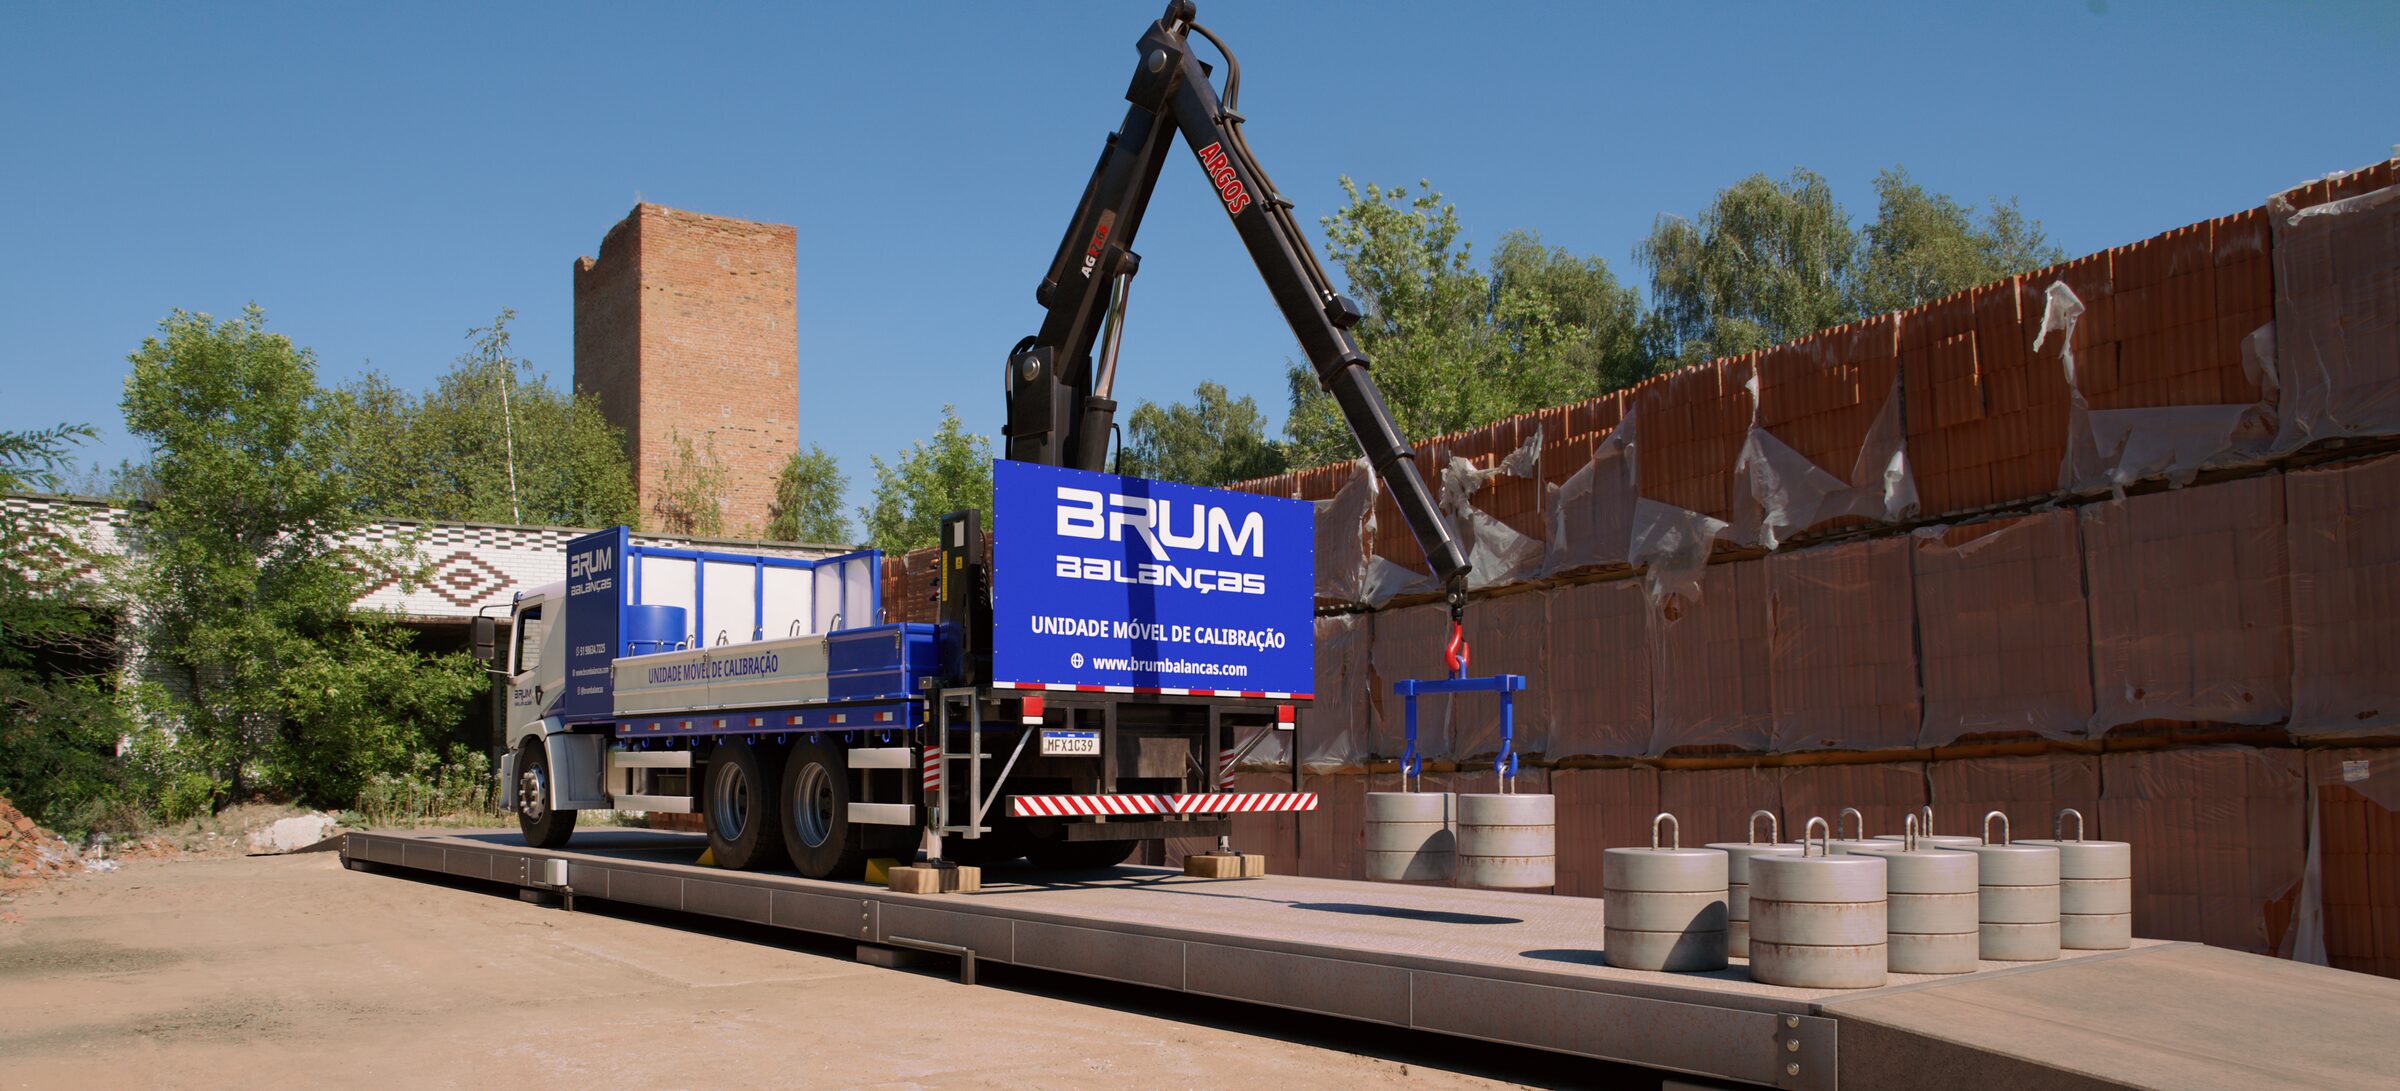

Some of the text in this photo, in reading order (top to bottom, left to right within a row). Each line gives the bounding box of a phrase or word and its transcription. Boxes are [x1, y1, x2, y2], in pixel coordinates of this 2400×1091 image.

[1199, 142, 1250, 213] ARGOS
[1057, 486, 1264, 561] BRUM
[571, 546, 612, 580] BRUM
[1031, 615, 1286, 652] UNIDADE MÓVEL DE CALIBRAÇÃO
[648, 651, 778, 684] UNIDADE MÓVEL DE CALIBRAÇÃO
[1093, 656, 1248, 677] www.brumbalancas.com
[1047, 739, 1093, 752] MFX1C39
